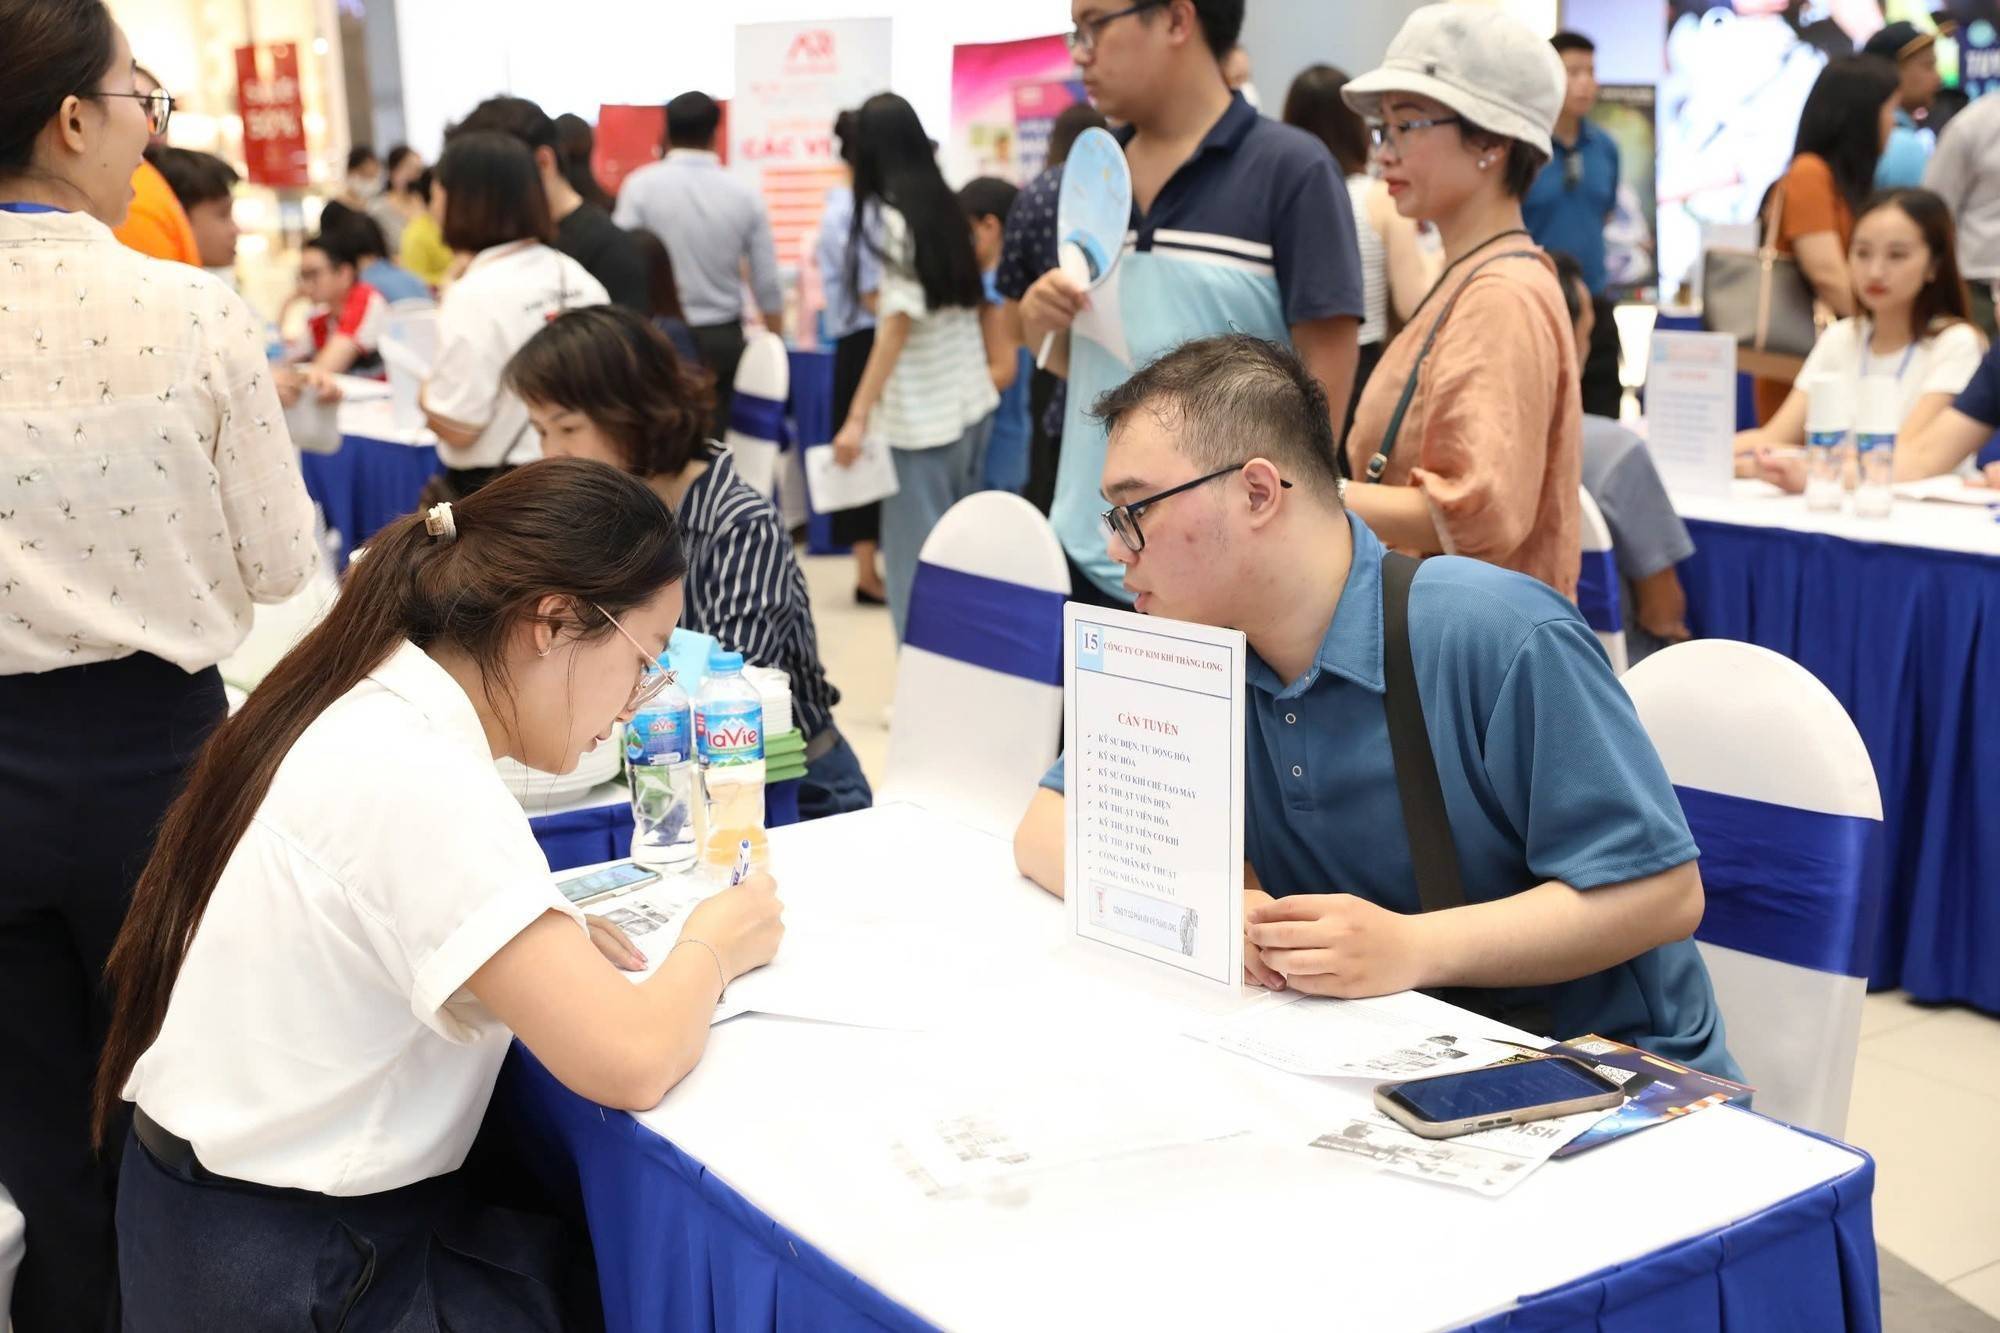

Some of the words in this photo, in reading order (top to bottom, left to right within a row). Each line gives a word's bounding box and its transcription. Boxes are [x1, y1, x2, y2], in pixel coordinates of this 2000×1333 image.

[1082, 632, 1098, 650] 15
[1124, 645, 1133, 656] TY
[1134, 648, 1145, 657] CP
[1145, 649, 1160, 661] KIM
[1202, 661, 1223, 673] LONG
[707, 726, 758, 748] laVie
